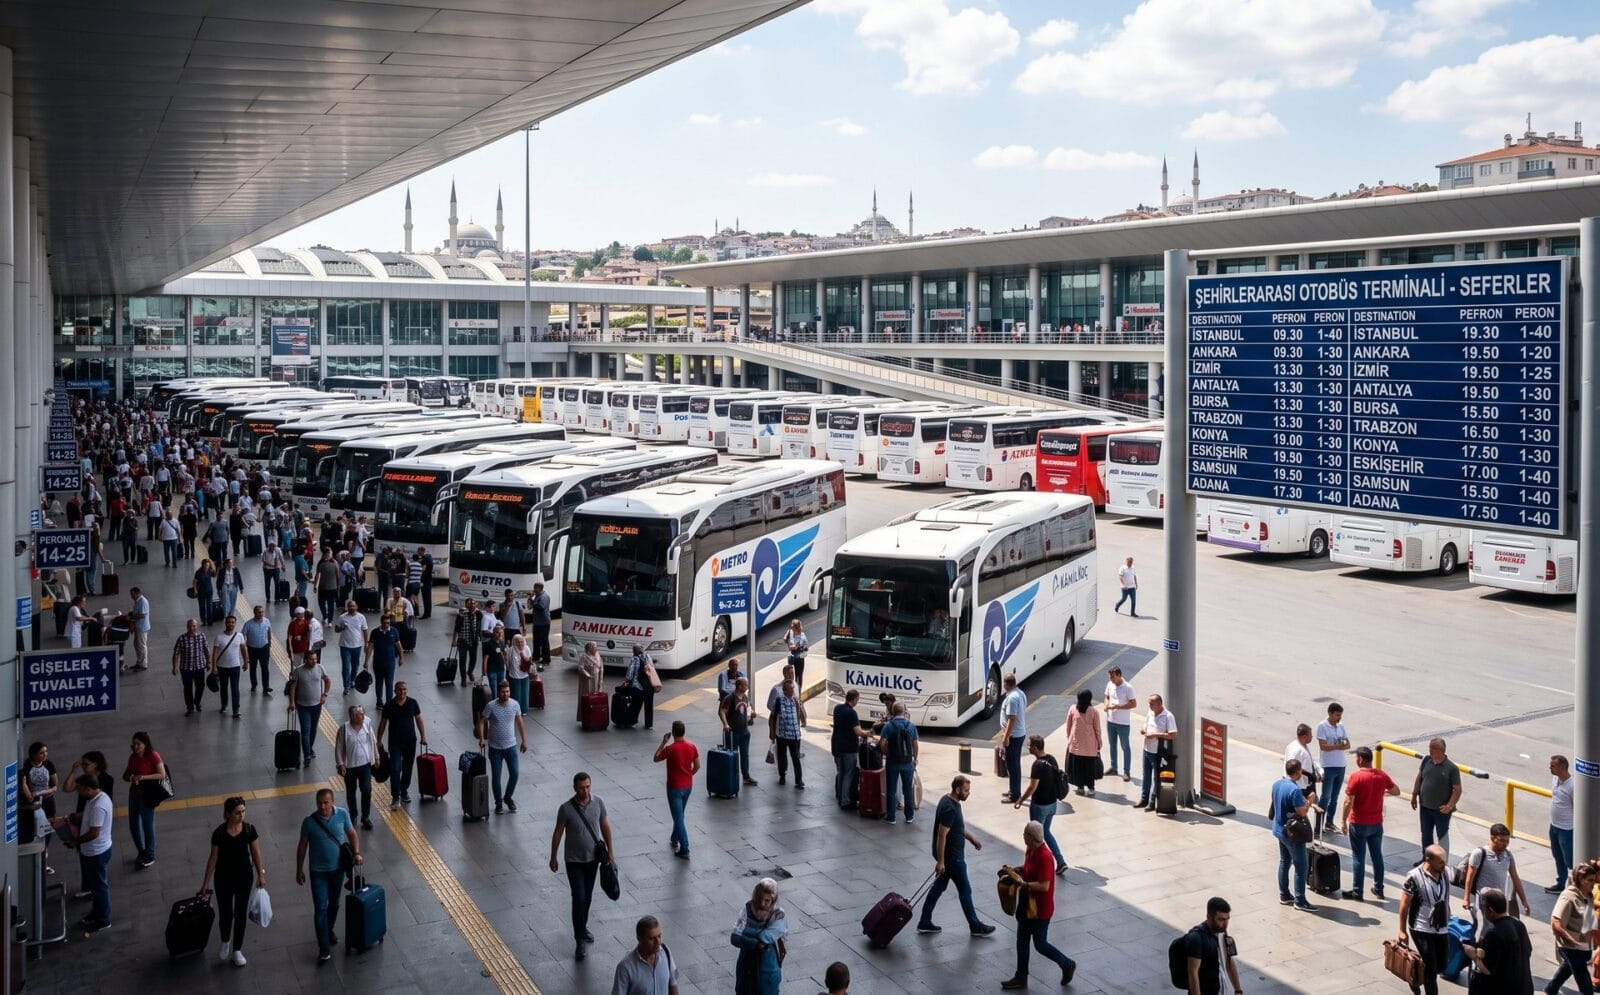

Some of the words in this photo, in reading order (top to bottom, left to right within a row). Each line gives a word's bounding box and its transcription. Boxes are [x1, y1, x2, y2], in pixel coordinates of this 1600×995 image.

[1195, 283, 1296, 308] ŞEHİRLERARASI
[1300, 279, 1358, 301] OTOBÜS
[1362, 273, 1445, 299] TERMİNALİ
[1460, 273, 1551, 296] SEFERLER
[1192, 314, 1242, 325] DESTINATION
[1272, 313, 1306, 323] PEFRON
[1314, 312, 1345, 322] PERON
[1354, 311, 1416, 322] DESTINATION
[1460, 308, 1503, 320] PEFRON
[1515, 307, 1555, 319] PERON
[1192, 326, 1244, 341] İSTANBUL
[1273, 329, 1303, 341] 09.30
[1318, 328, 1342, 340] 1-40
[1353, 326, 1419, 340] İSTANBUL
[1462, 326, 1499, 339] 19.30
[1520, 325, 1552, 338] 1-40
[1192, 346, 1238, 358] ANKARA
[1273, 346, 1303, 358] 09.30
[1318, 346, 1342, 359] 1-30
[1353, 346, 1410, 359] ANKARA
[1462, 346, 1499, 359] 19.50
[1520, 346, 1552, 359] 1-20
[1192, 361, 1221, 374] İZMİR
[1273, 364, 1303, 376] 13.30
[1318, 364, 1342, 377] 1-30
[1353, 361, 1389, 377] İZMİR
[1462, 366, 1499, 379] 19.50
[1520, 367, 1552, 380] 1-25
[1192, 379, 1240, 391] ANTALYA
[1273, 381, 1303, 393] 13.30
[1318, 382, 1342, 394] 1-30
[1353, 383, 1413, 396] ANTALYA
[1462, 386, 1499, 399] 19.50
[1520, 387, 1552, 400] 1-30
[1192, 395, 1229, 407] BURSA
[1273, 398, 1303, 411] 13.30
[1318, 400, 1342, 413] 1-30
[1353, 401, 1399, 415] BURSA
[1462, 406, 1499, 420] 15.50
[1520, 408, 1552, 422] 1-30
[1192, 412, 1243, 425] TRABZON
[1273, 416, 1303, 428] 13.30
[1318, 418, 1342, 431] 1-30
[1192, 428, 1229, 441] KONYA
[1273, 433, 1303, 446] 19.00
[1318, 436, 1342, 449] 1-30
[1353, 420, 1417, 435] TRABZON
[1462, 425, 1499, 439] 16.50
[1520, 428, 1552, 442] 1-30
[50, 451, 76, 460] 14-25
[1192, 443, 1248, 460] ESKİŞEHİR
[1318, 454, 1342, 467] 1-30
[1353, 438, 1399, 453] KONYA
[1462, 445, 1499, 459] 17.50
[1520, 449, 1552, 463] 1-30
[1192, 461, 1237, 475] SAMSUN
[1273, 468, 1303, 481] 19.50
[1318, 472, 1342, 485] 1-30
[1353, 456, 1424, 474] ESKİŞEHİR
[1462, 465, 1499, 479] 17.00
[1520, 469, 1552, 484] 1-40
[46, 478, 79, 489] 14-25
[1192, 478, 1230, 492] ADANA
[1273, 486, 1303, 499] 17.30
[1318, 490, 1342, 503] 1-40
[1353, 475, 1409, 492] SAMSUN
[1462, 484, 1499, 499] 15.50
[1520, 489, 1552, 505] 1-40
[1353, 494, 1400, 510] ADANA
[1462, 504, 1499, 520] 17.50
[1520, 510, 1552, 525] 1-40
[40, 546, 86, 563] 14-25
[721, 551, 748, 571] METRO
[471, 573, 512, 587] METRO
[572, 620, 654, 637] PAMUKKALE
[30, 659, 90, 676] GİŞELER
[30, 676, 95, 693] TUVALET
[30, 694, 96, 711] DANIŞMA
